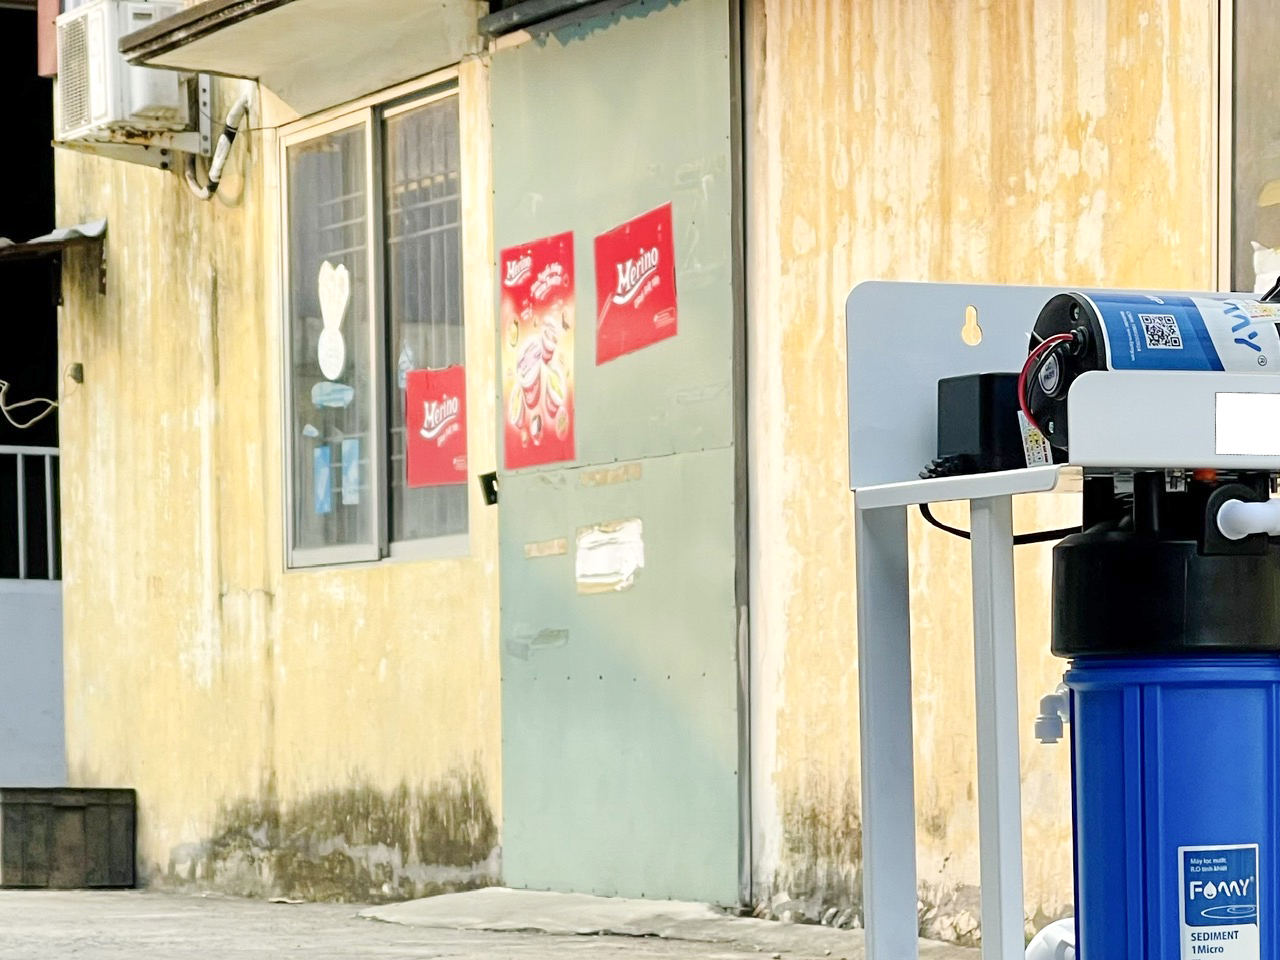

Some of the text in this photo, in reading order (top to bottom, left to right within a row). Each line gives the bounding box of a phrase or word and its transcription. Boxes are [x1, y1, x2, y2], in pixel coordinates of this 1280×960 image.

[506, 255, 532, 280] Merino
[616, 247, 659, 294] Merino
[423, 393, 459, 428] Merino
[1191, 930, 1239, 941] SEDIMENT
